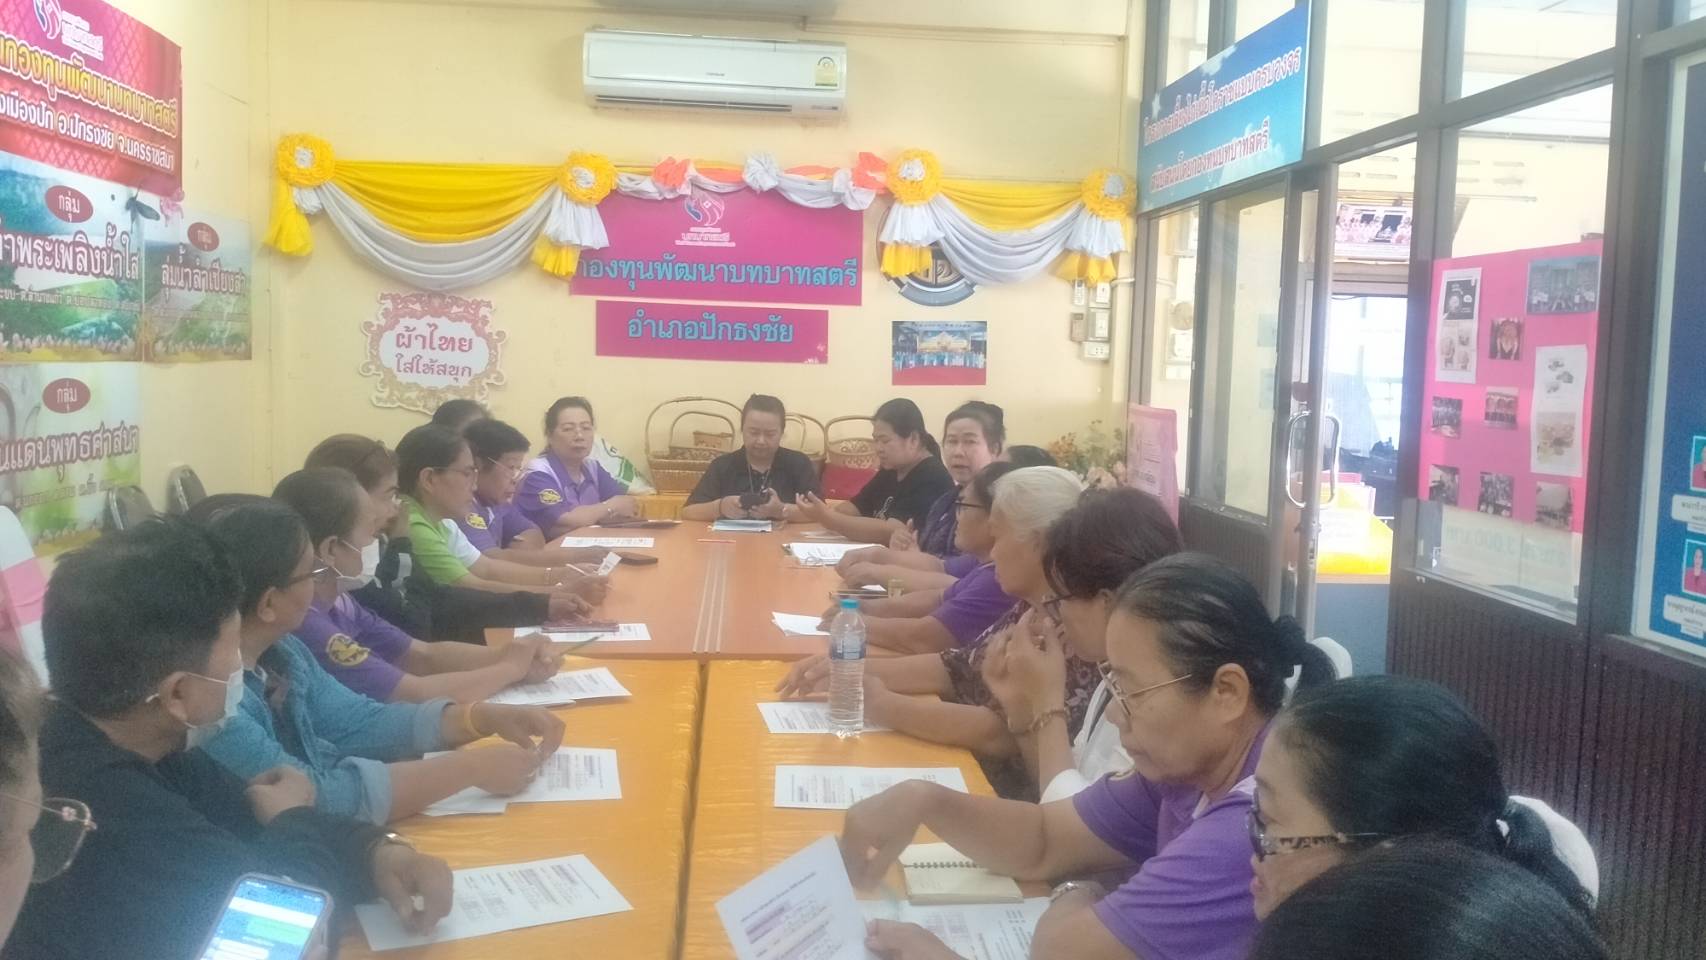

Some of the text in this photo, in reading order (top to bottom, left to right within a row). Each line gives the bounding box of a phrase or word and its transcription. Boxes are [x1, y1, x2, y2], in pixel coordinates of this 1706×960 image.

[0, 33, 177, 136] กองทุนพัฒนาบทบาทสตรี
[58, 113, 114, 149] อ.ปักธงชัย
[119, 135, 175, 171] จ.นครราชสีมา
[58, 191, 81, 222] กลุ่ม
[0, 223, 140, 280] าพระเพลิงน้ำใส
[395, 323, 473, 353] ผ้าไทย
[627, 309, 794, 343] อำเภอปักธงชัย
[395, 353, 472, 382] ใส่ให้สนุก
[57, 381, 78, 412] กลุ่ม
